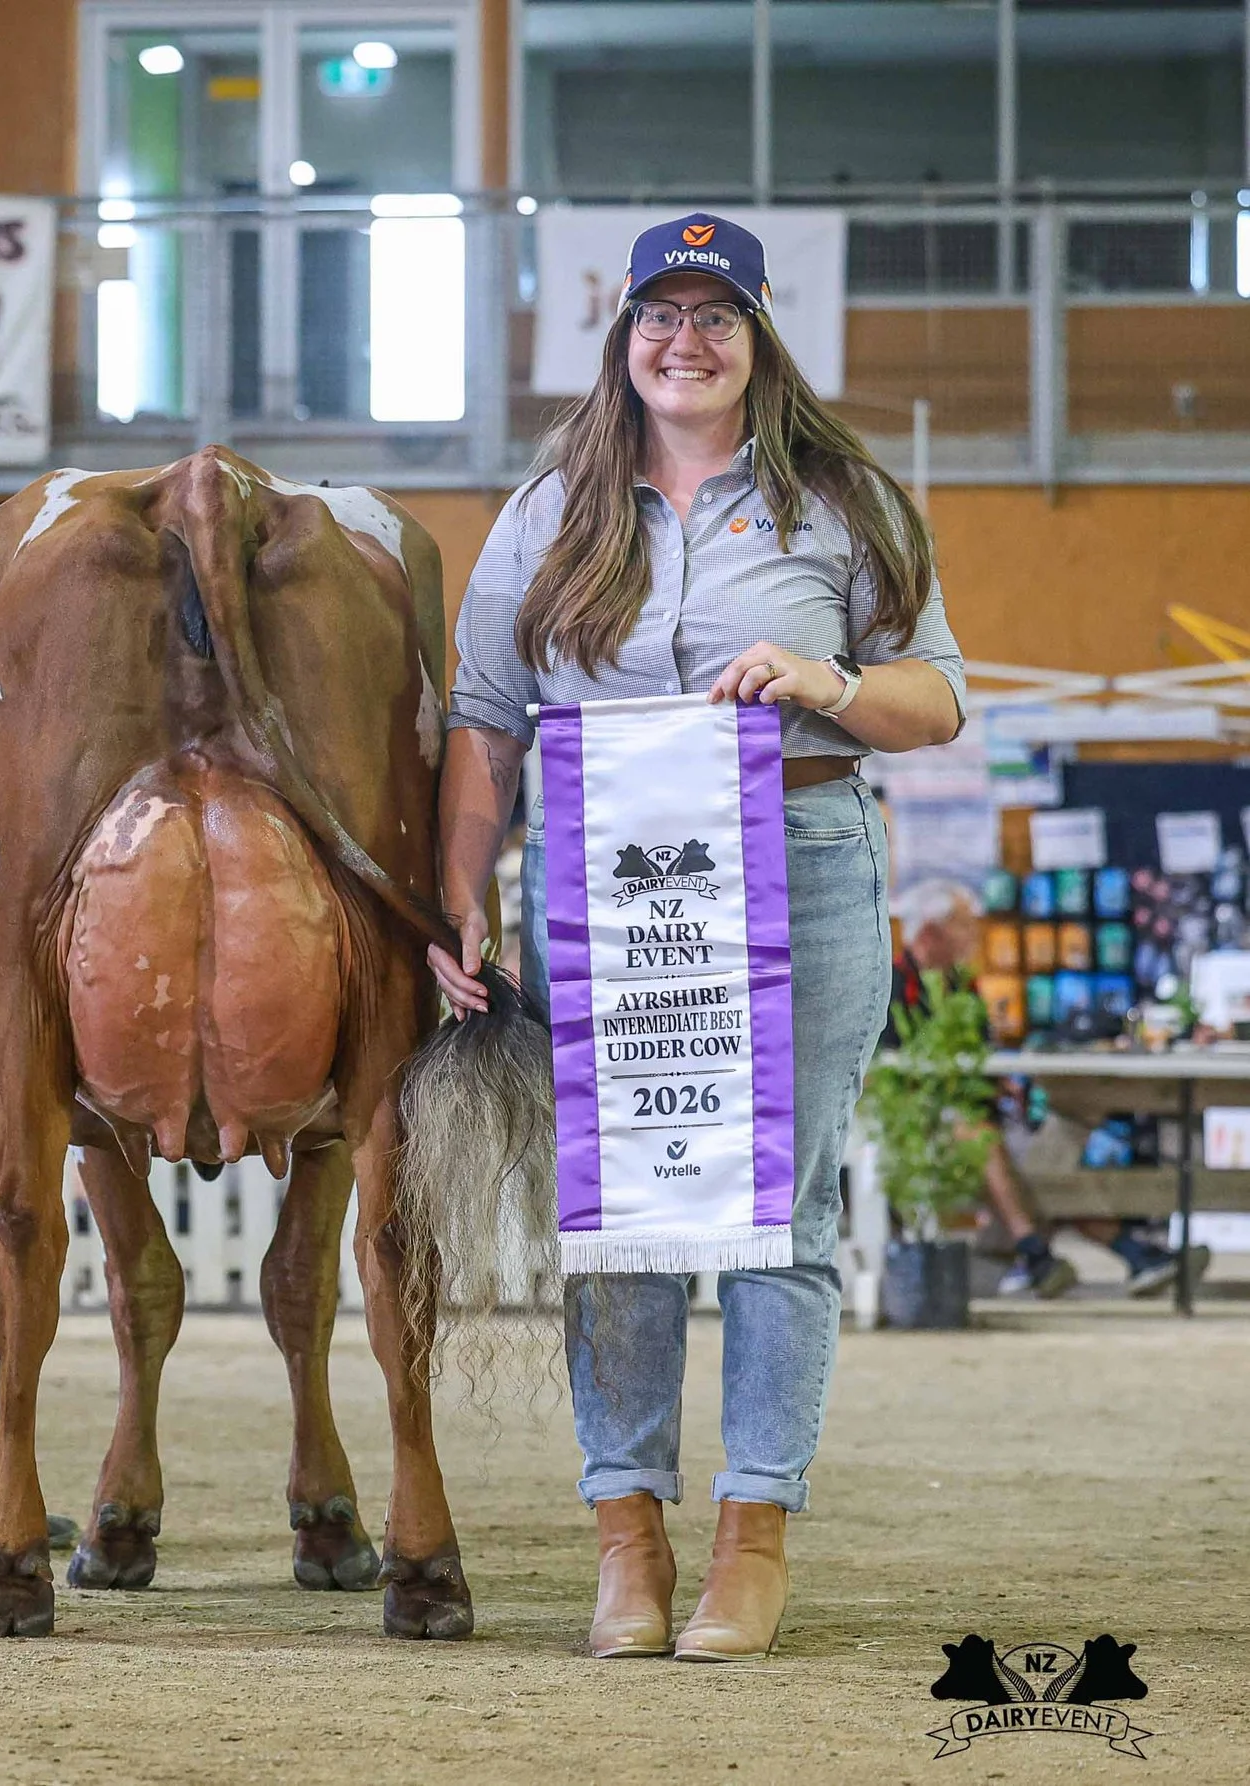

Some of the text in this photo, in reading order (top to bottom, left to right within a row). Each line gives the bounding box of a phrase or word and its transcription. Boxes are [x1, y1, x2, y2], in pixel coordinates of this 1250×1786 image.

[664, 249, 731, 271] Vytelle
[755, 518, 813, 533] Vylle
[655, 850, 672, 862] NZ
[648, 898, 684, 920] NZ
[625, 921, 709, 944] DAIRY
[625, 945, 714, 969] EVENT
[614, 985, 729, 1013] AYRSHIRE
[602, 1009, 743, 1037] INTERMEDIATE BEST
[605, 1035, 742, 1062] UDDER COW
[632, 1082, 721, 1117] 2026
[653, 1163, 702, 1179] Vytelle
